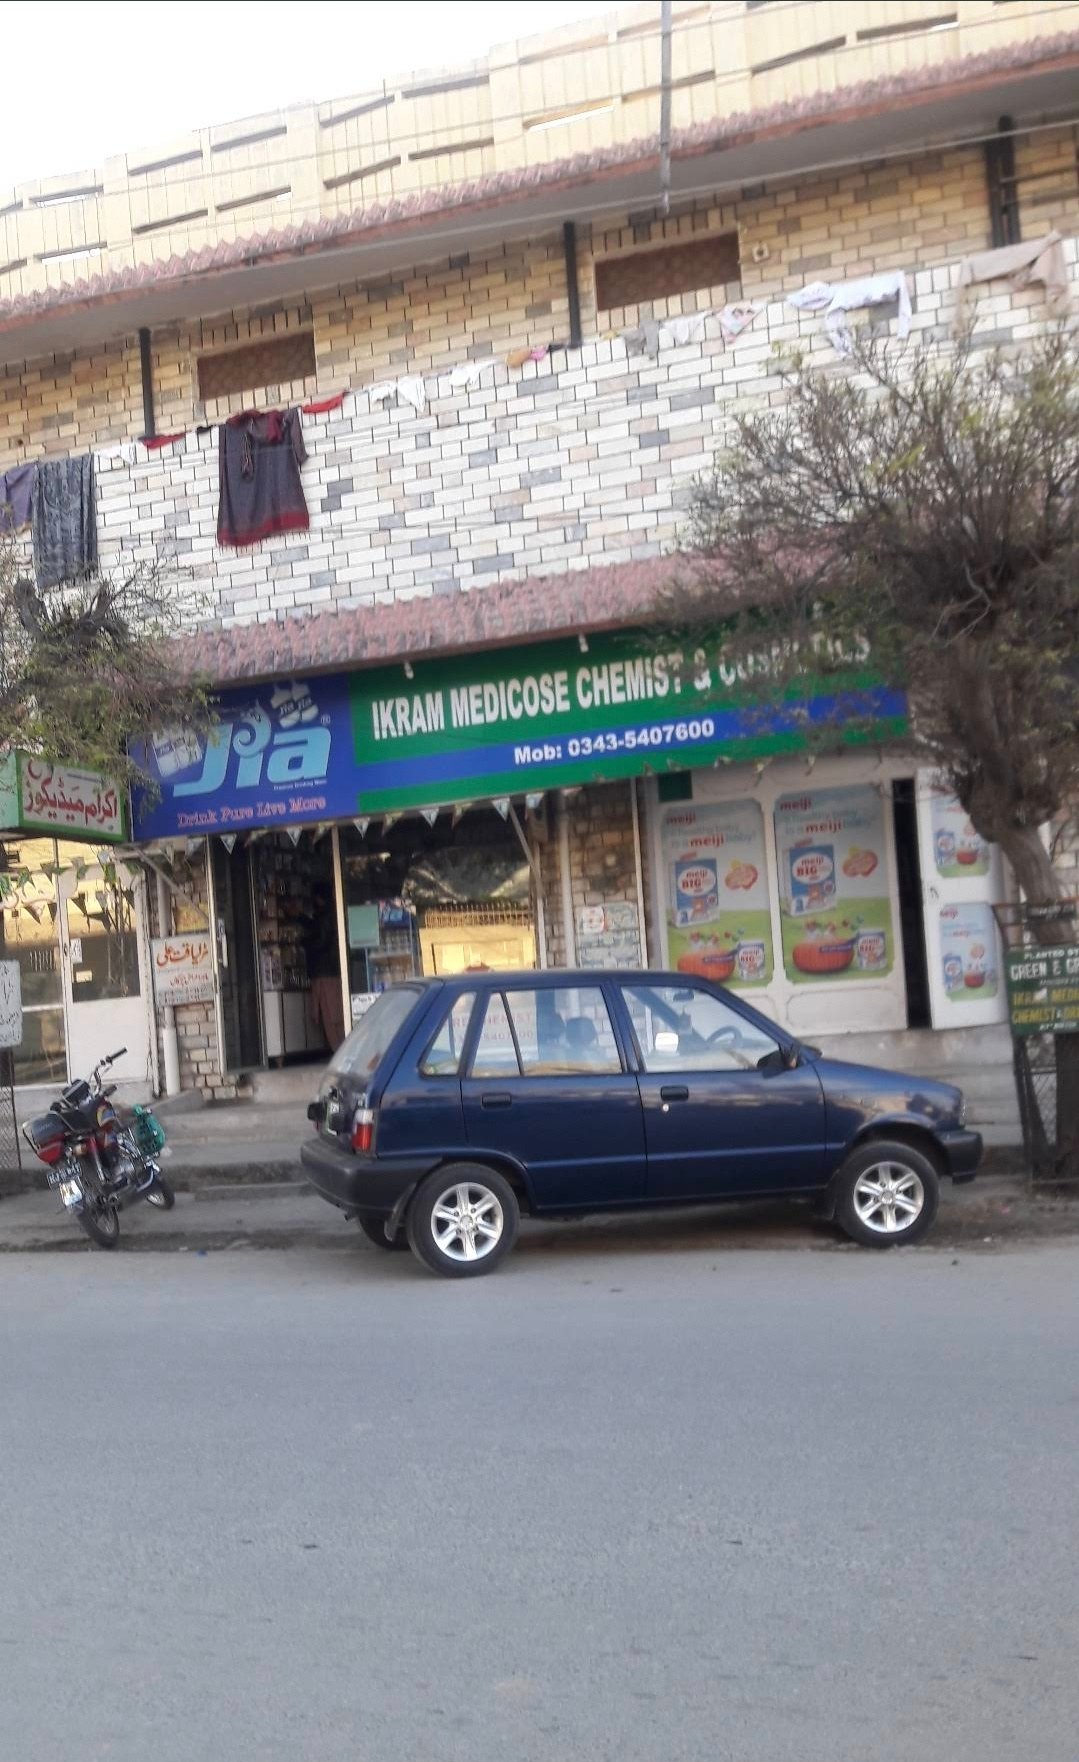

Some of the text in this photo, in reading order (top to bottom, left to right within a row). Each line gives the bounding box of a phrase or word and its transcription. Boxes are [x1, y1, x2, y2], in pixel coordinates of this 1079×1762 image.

[372, 691, 445, 740] IKRAM
[450, 670, 571, 729] MEDICOSE
[576, 650, 684, 710] CHEMIST
[694, 648, 712, 690] &
[173, 700, 332, 797] Jia
[514, 718, 715, 765] Mob: 0343-5407600
[82, 788, 118, 827] اکرام
[177, 795, 327, 828] Drink Pure Live More
[805, 819, 842, 834] meiji
[690, 832, 724, 849] meiji
[681, 879, 702, 890] BIG
[796, 867, 818, 878] BIG
[1010, 961, 1047, 981] GREEN
